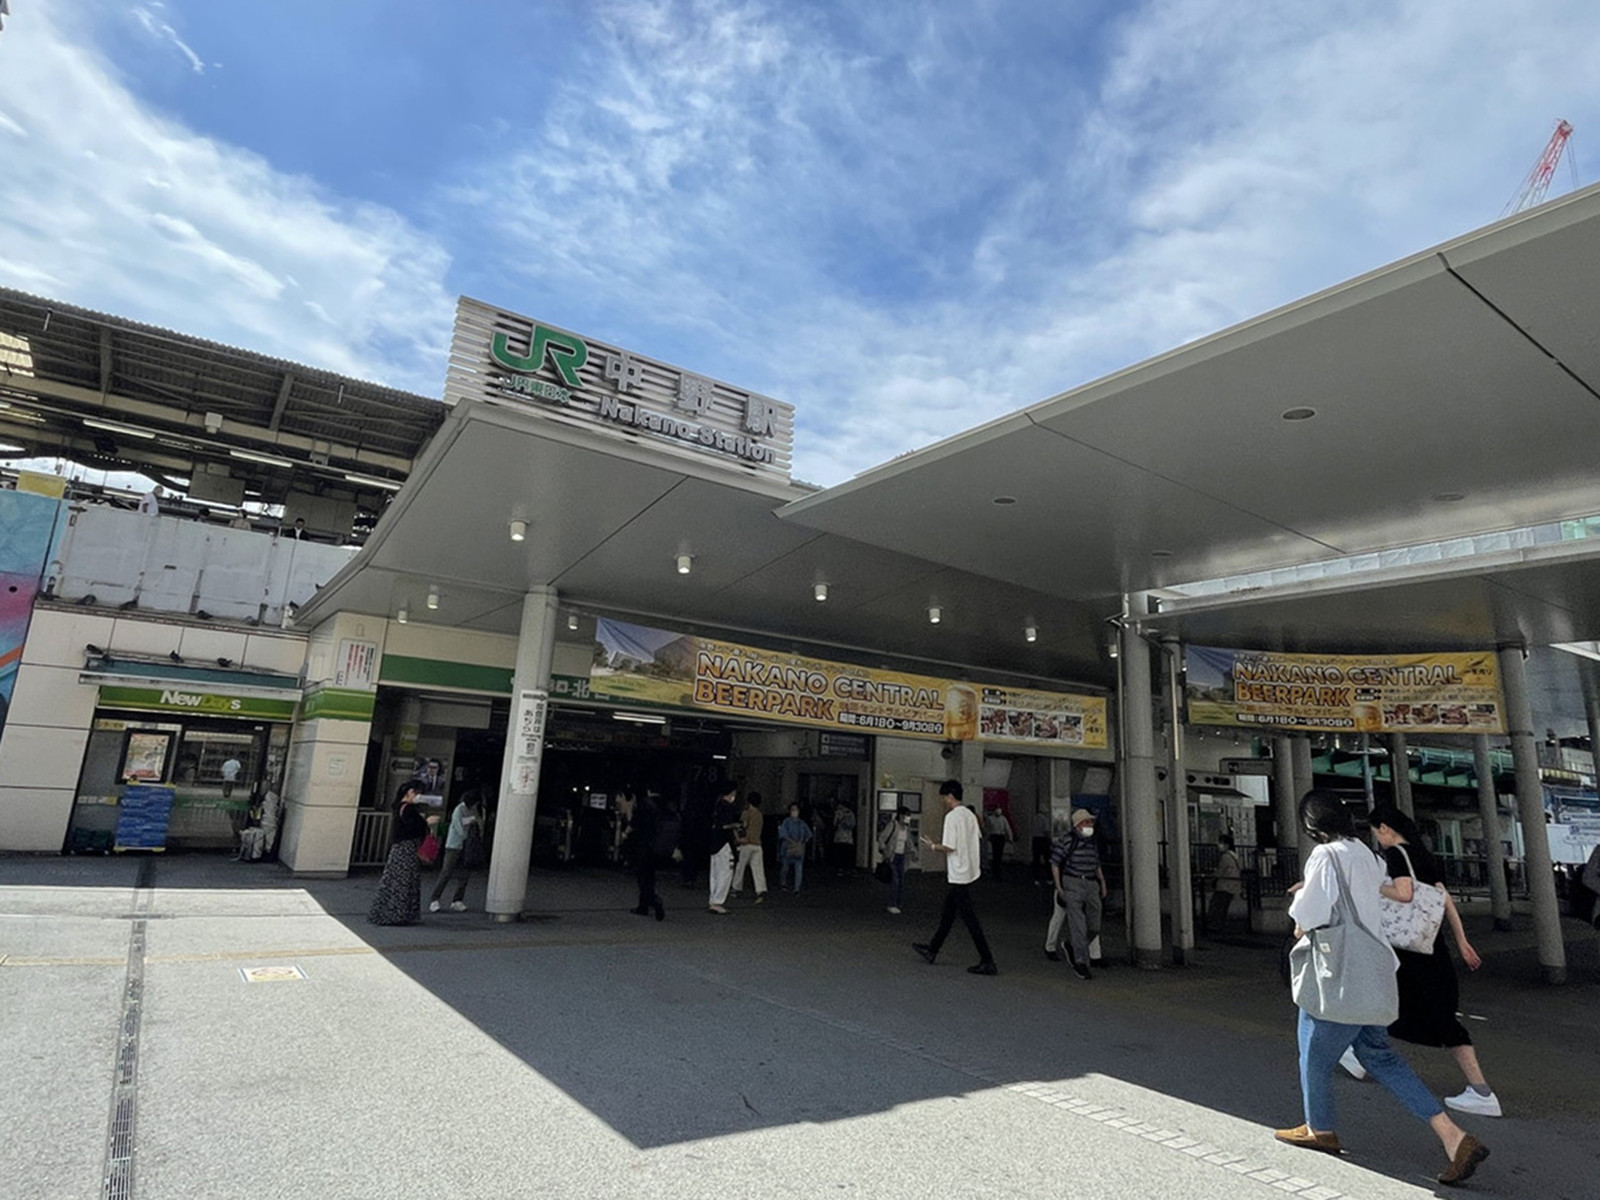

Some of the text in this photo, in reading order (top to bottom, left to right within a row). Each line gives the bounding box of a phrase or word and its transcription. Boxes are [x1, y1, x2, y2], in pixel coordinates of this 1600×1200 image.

[491, 325, 585, 388] JR
[601, 396, 777, 464] Nakano Station
[697, 651, 829, 695] NAKANO
[833, 676, 945, 711] CENTRAL
[1234, 660, 1463, 686] NAKANO CENTRAL
[1235, 681, 1351, 707] BEERPARK
[160, 689, 241, 711] NewDays
[694, 678, 835, 721] BEERPARK
